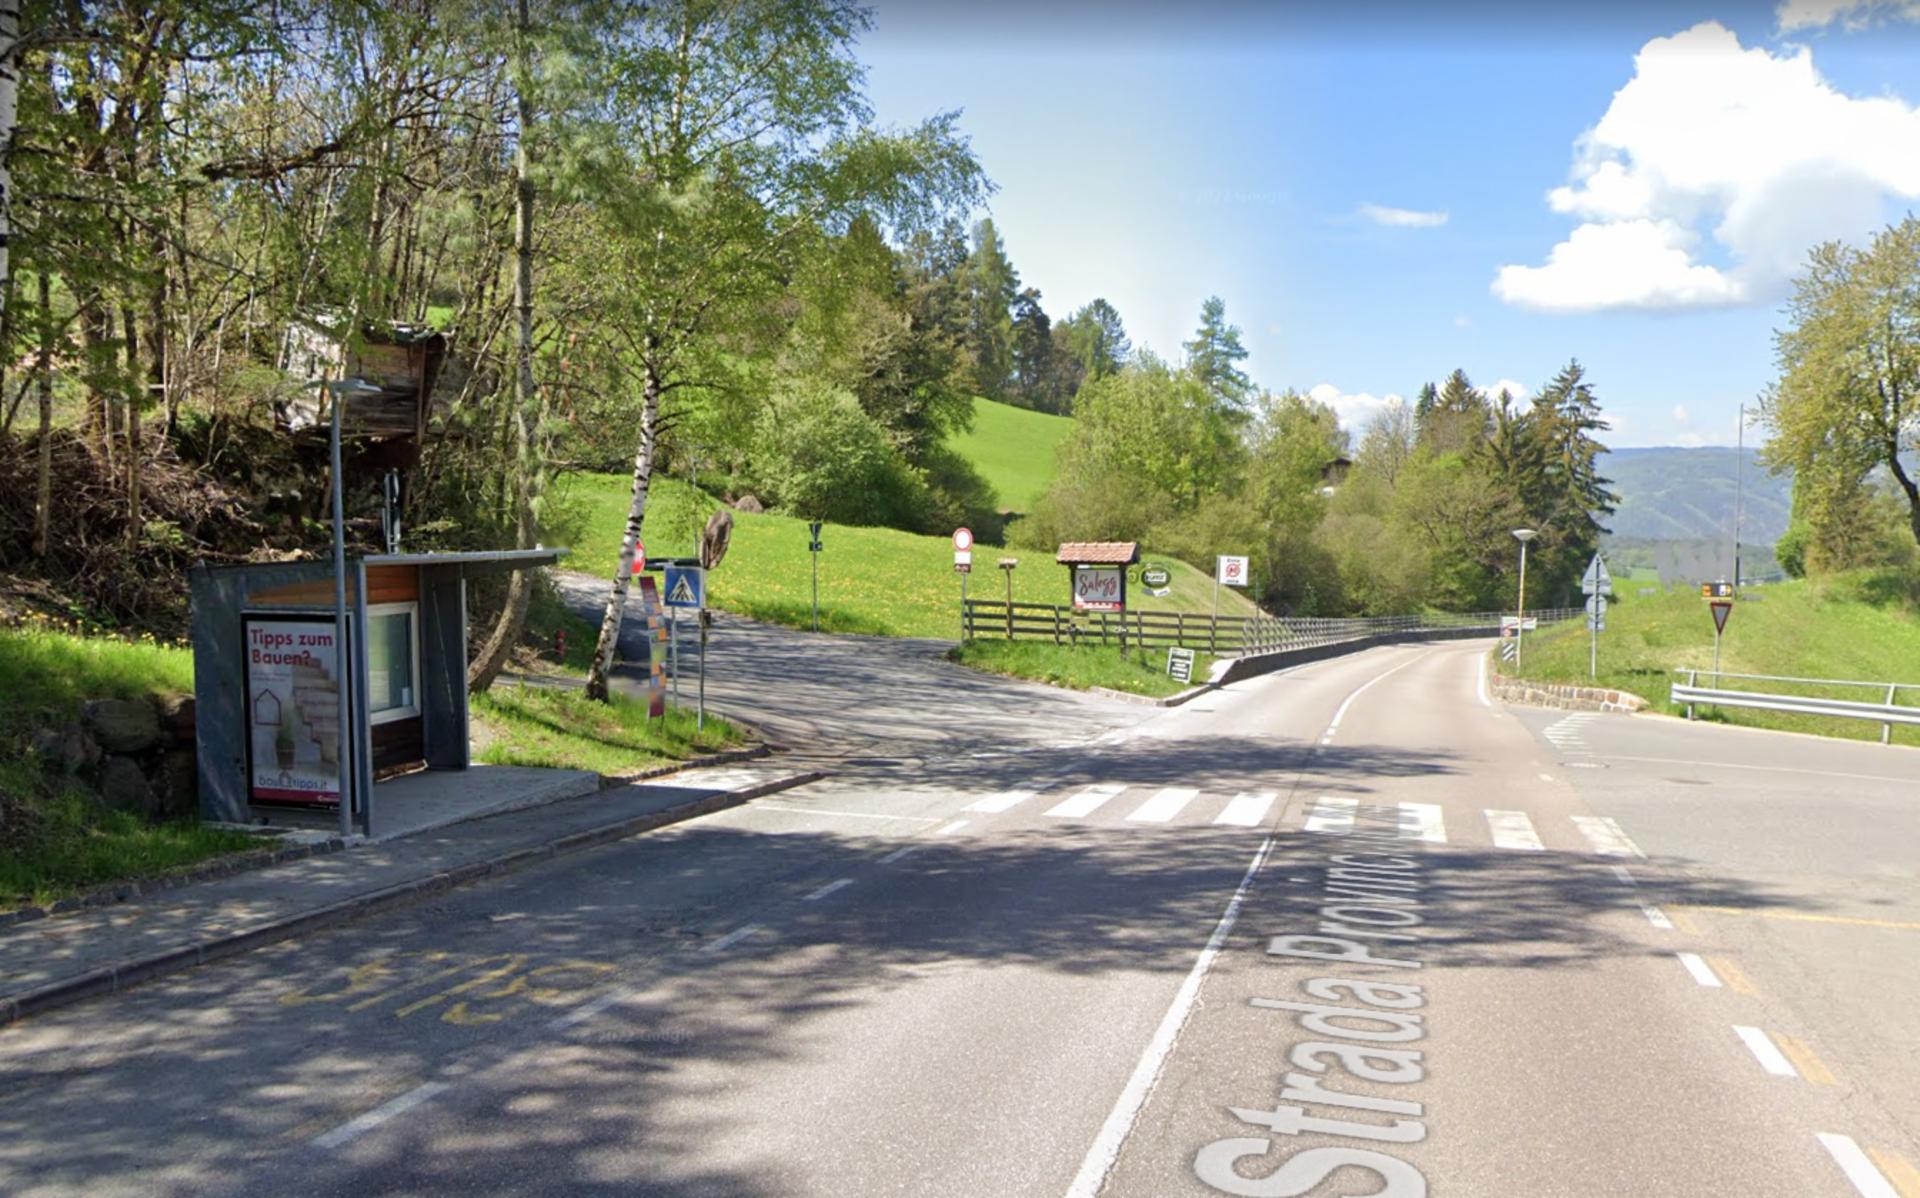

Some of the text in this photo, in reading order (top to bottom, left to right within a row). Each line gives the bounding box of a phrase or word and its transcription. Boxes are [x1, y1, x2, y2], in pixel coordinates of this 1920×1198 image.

[1078, 570, 1117, 597] Salegg
[250, 628, 333, 649] Tipps zum
[251, 648, 311, 667] Bauen?
